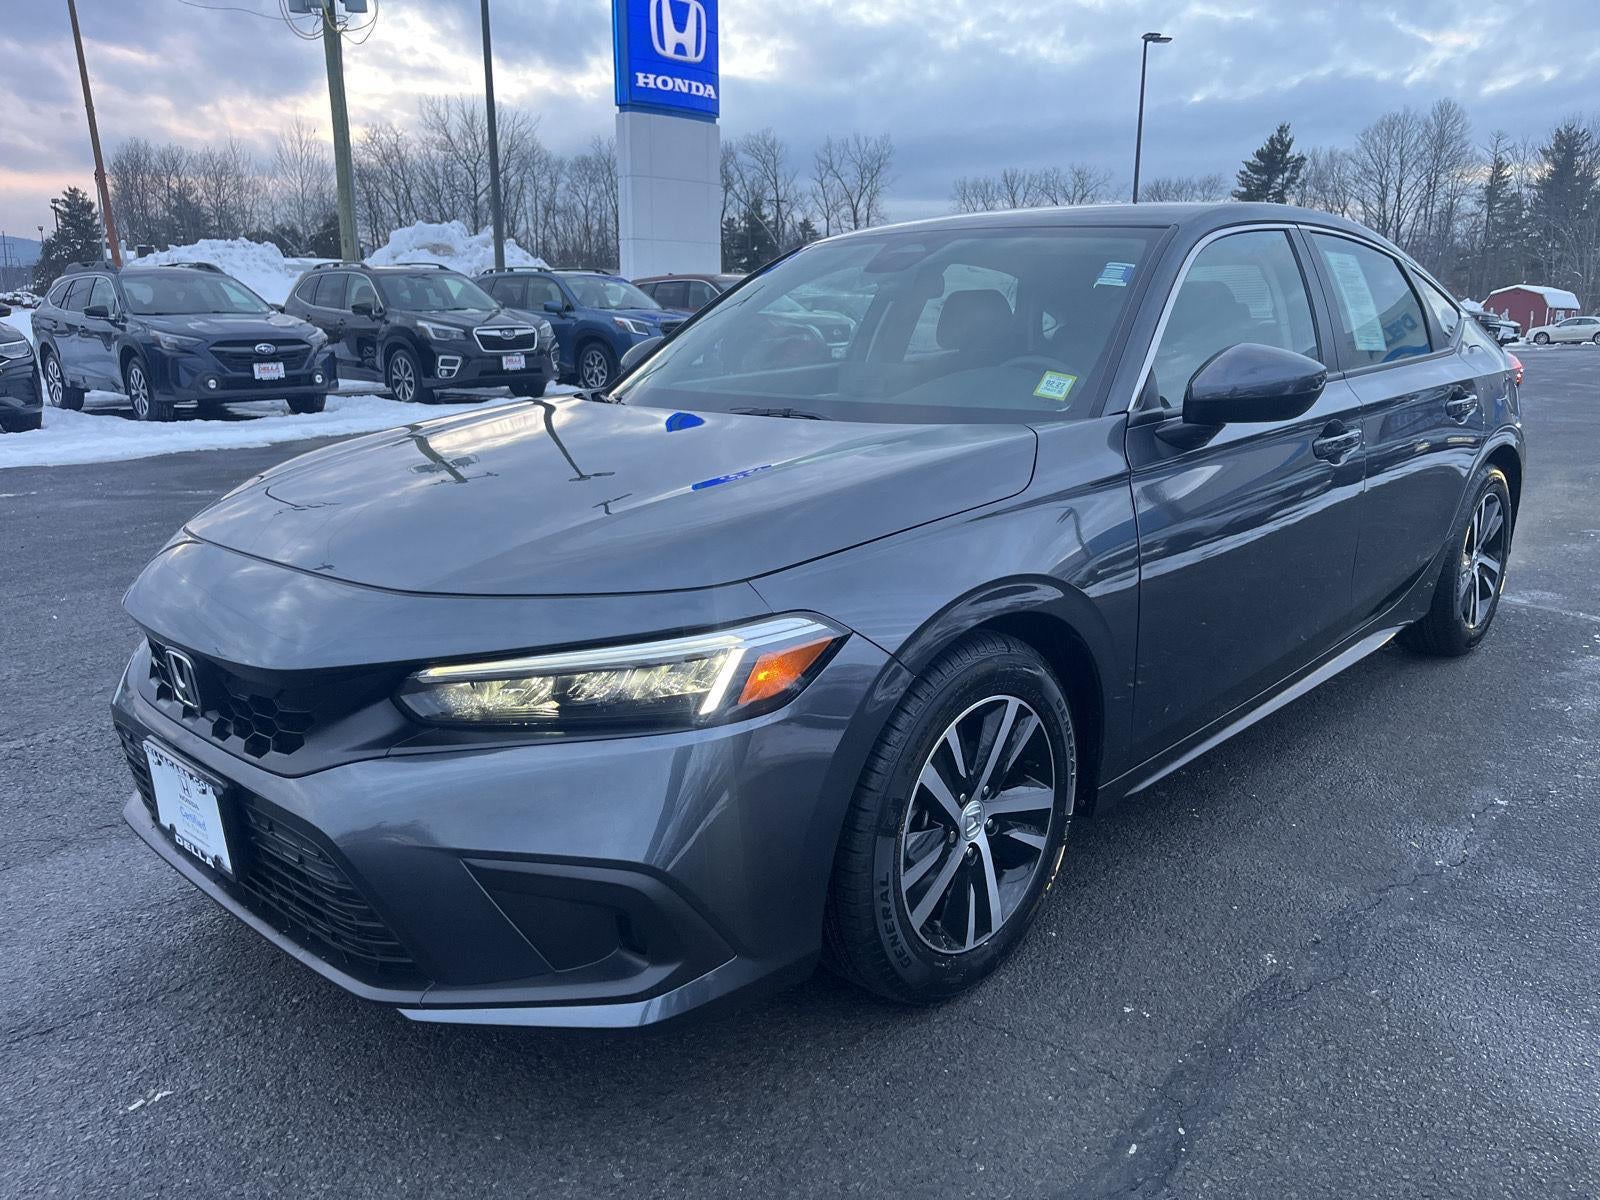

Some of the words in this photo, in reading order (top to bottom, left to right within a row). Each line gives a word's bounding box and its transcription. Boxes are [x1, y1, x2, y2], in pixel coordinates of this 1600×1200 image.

[635, 72, 718, 100] HONDA
[175, 834, 215, 869] DELLA
[880, 872, 911, 969] GENERAL
